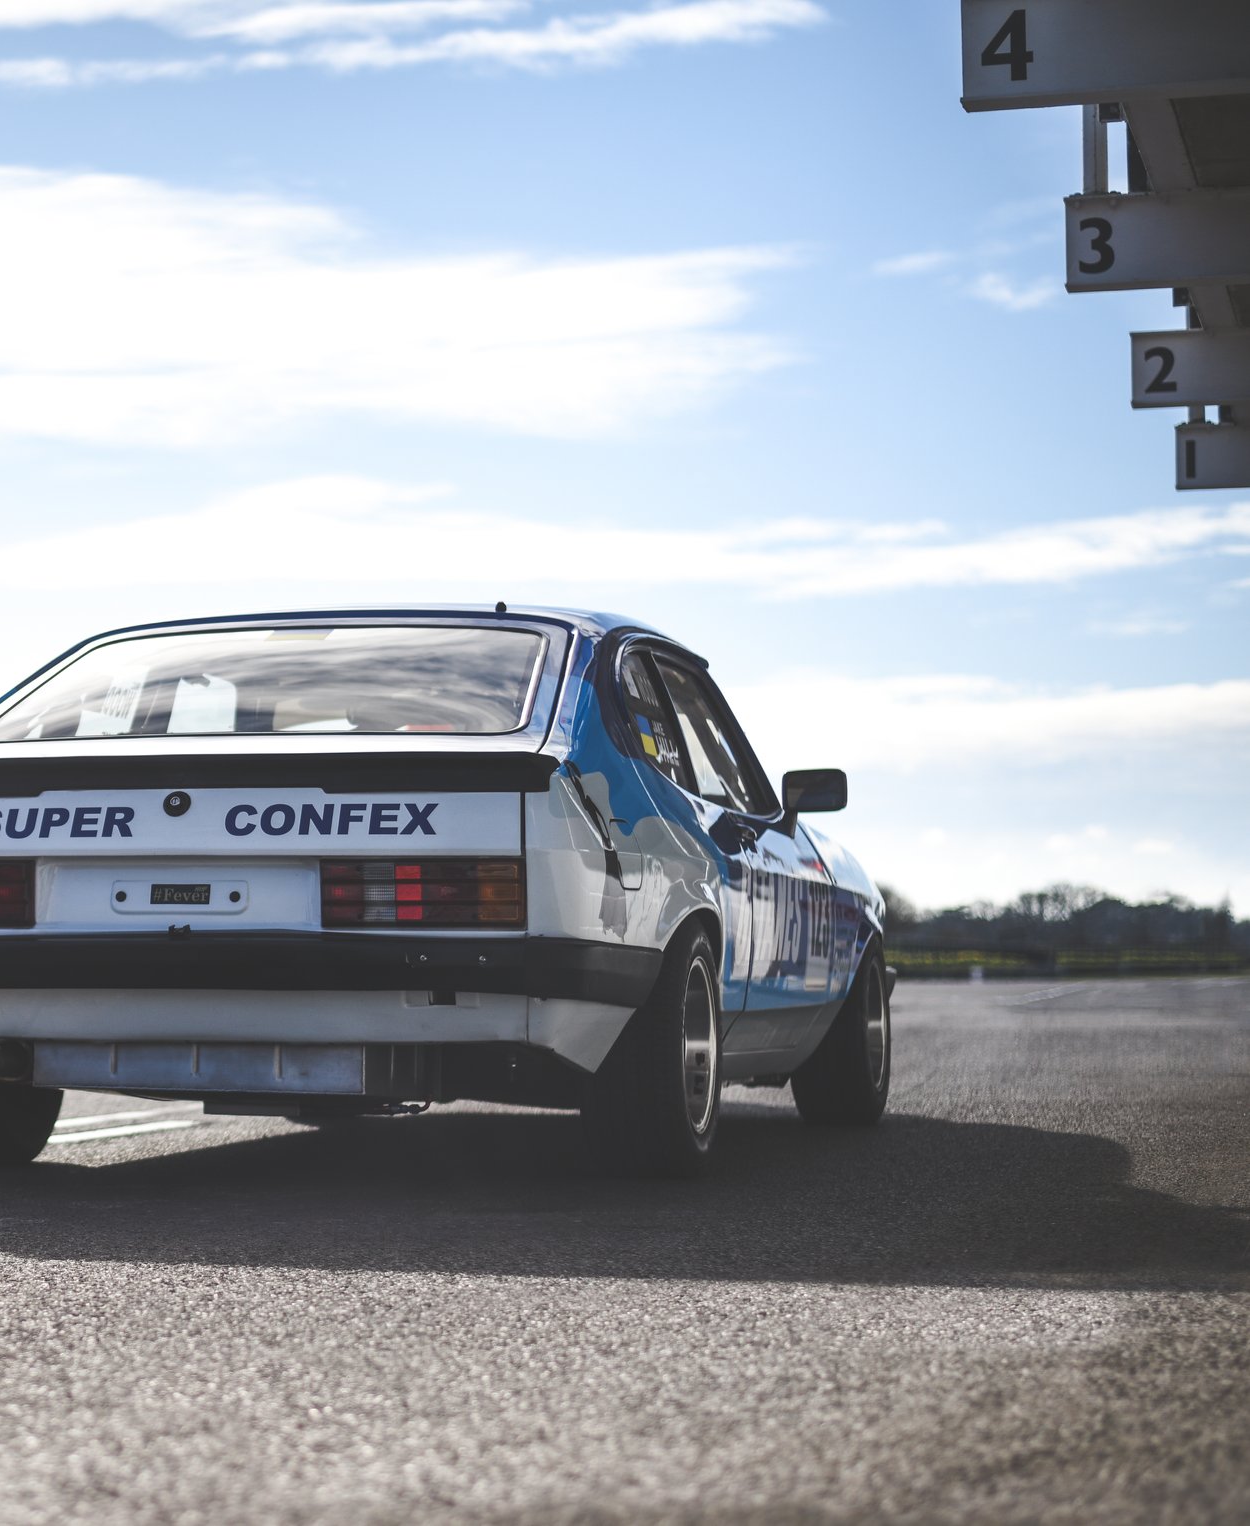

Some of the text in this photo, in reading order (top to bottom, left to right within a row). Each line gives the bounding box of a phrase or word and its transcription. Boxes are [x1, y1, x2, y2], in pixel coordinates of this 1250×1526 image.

[981, 9, 1034, 81] 4
[1079, 217, 1115, 274] 3
[1143, 347, 1177, 394] 2
[224, 803, 439, 836] CONFEX
[153, 887, 208, 902] #Fever
